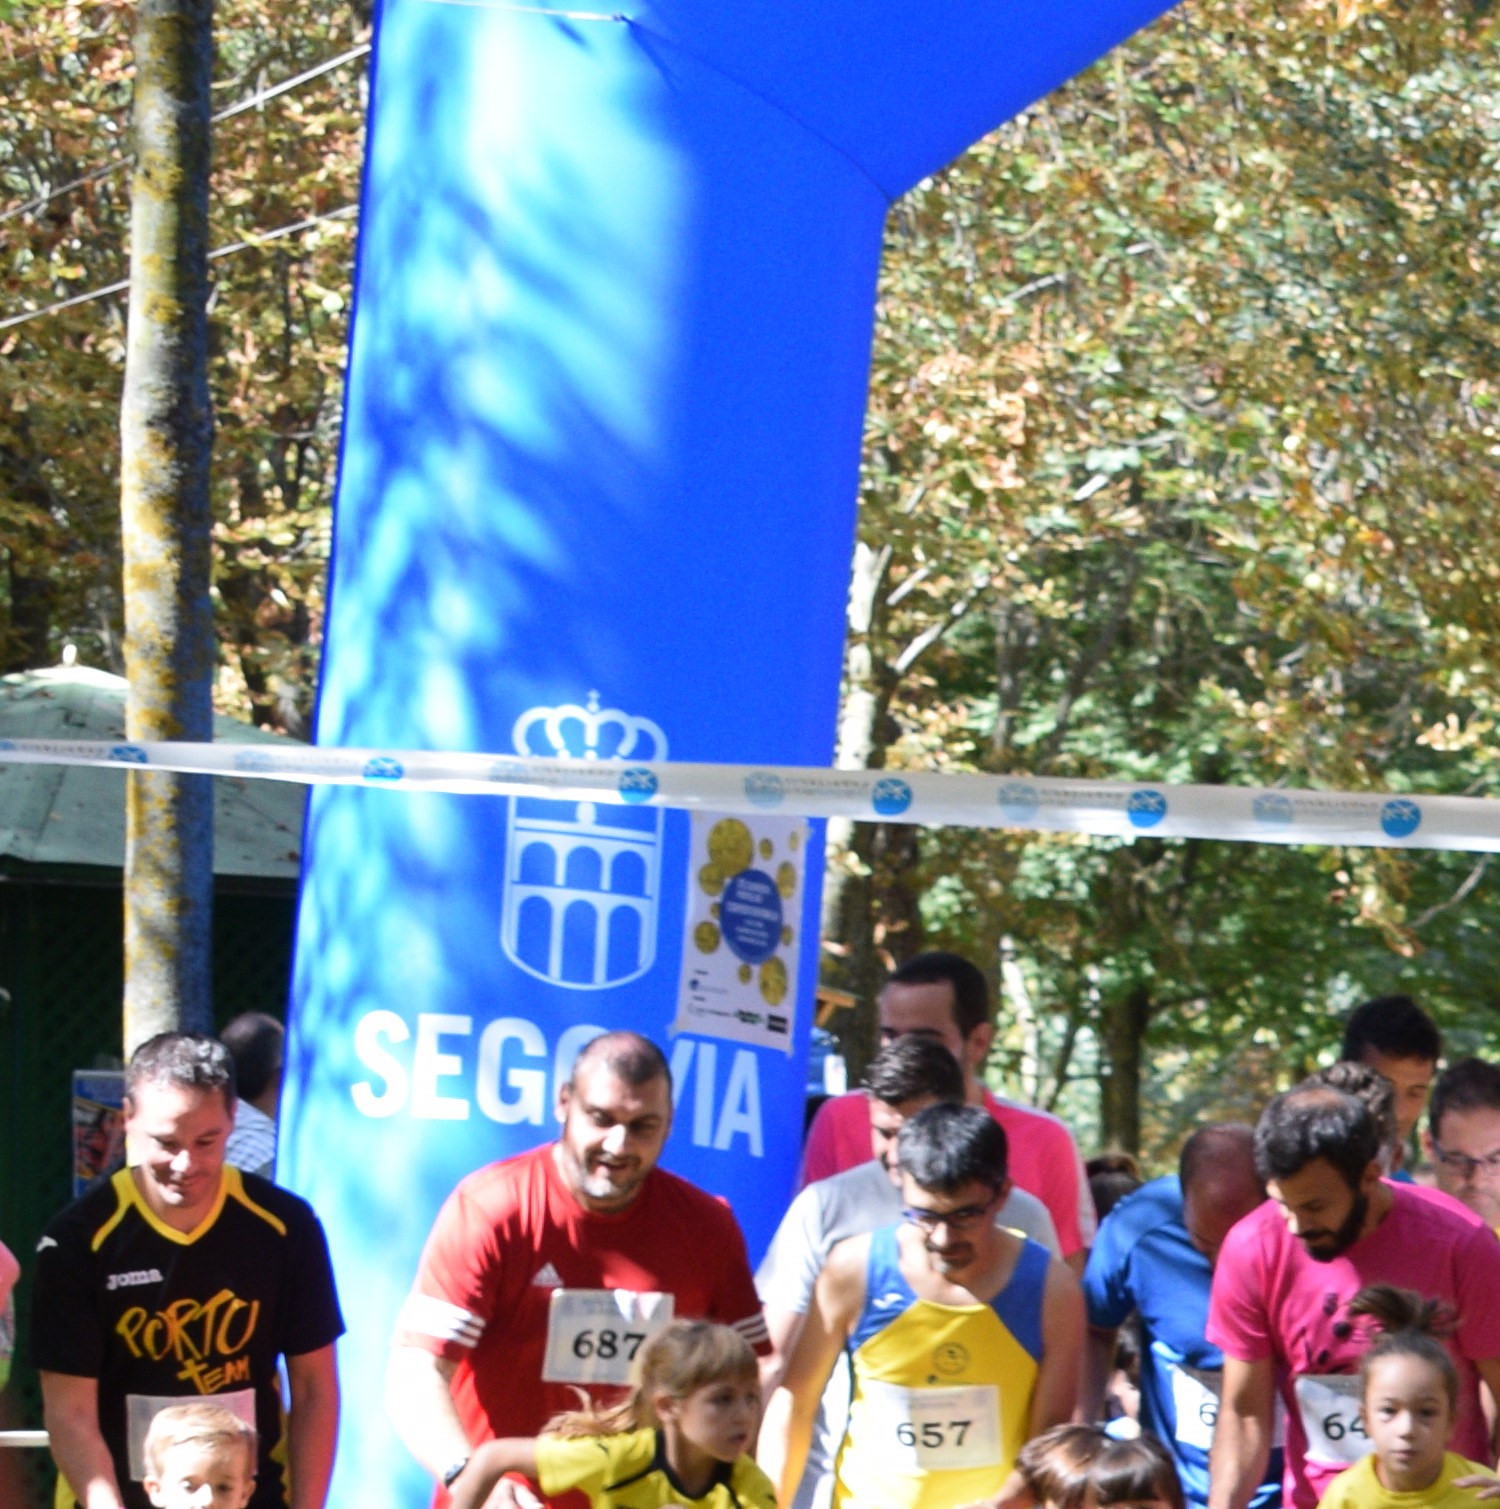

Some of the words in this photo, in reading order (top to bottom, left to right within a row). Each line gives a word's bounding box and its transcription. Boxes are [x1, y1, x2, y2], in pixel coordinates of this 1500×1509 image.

[115, 1288, 260, 1361] PORTO
[573, 1330, 646, 1360] 687
[896, 1420, 972, 1448] 657
[1323, 1412, 1369, 1441] 64
